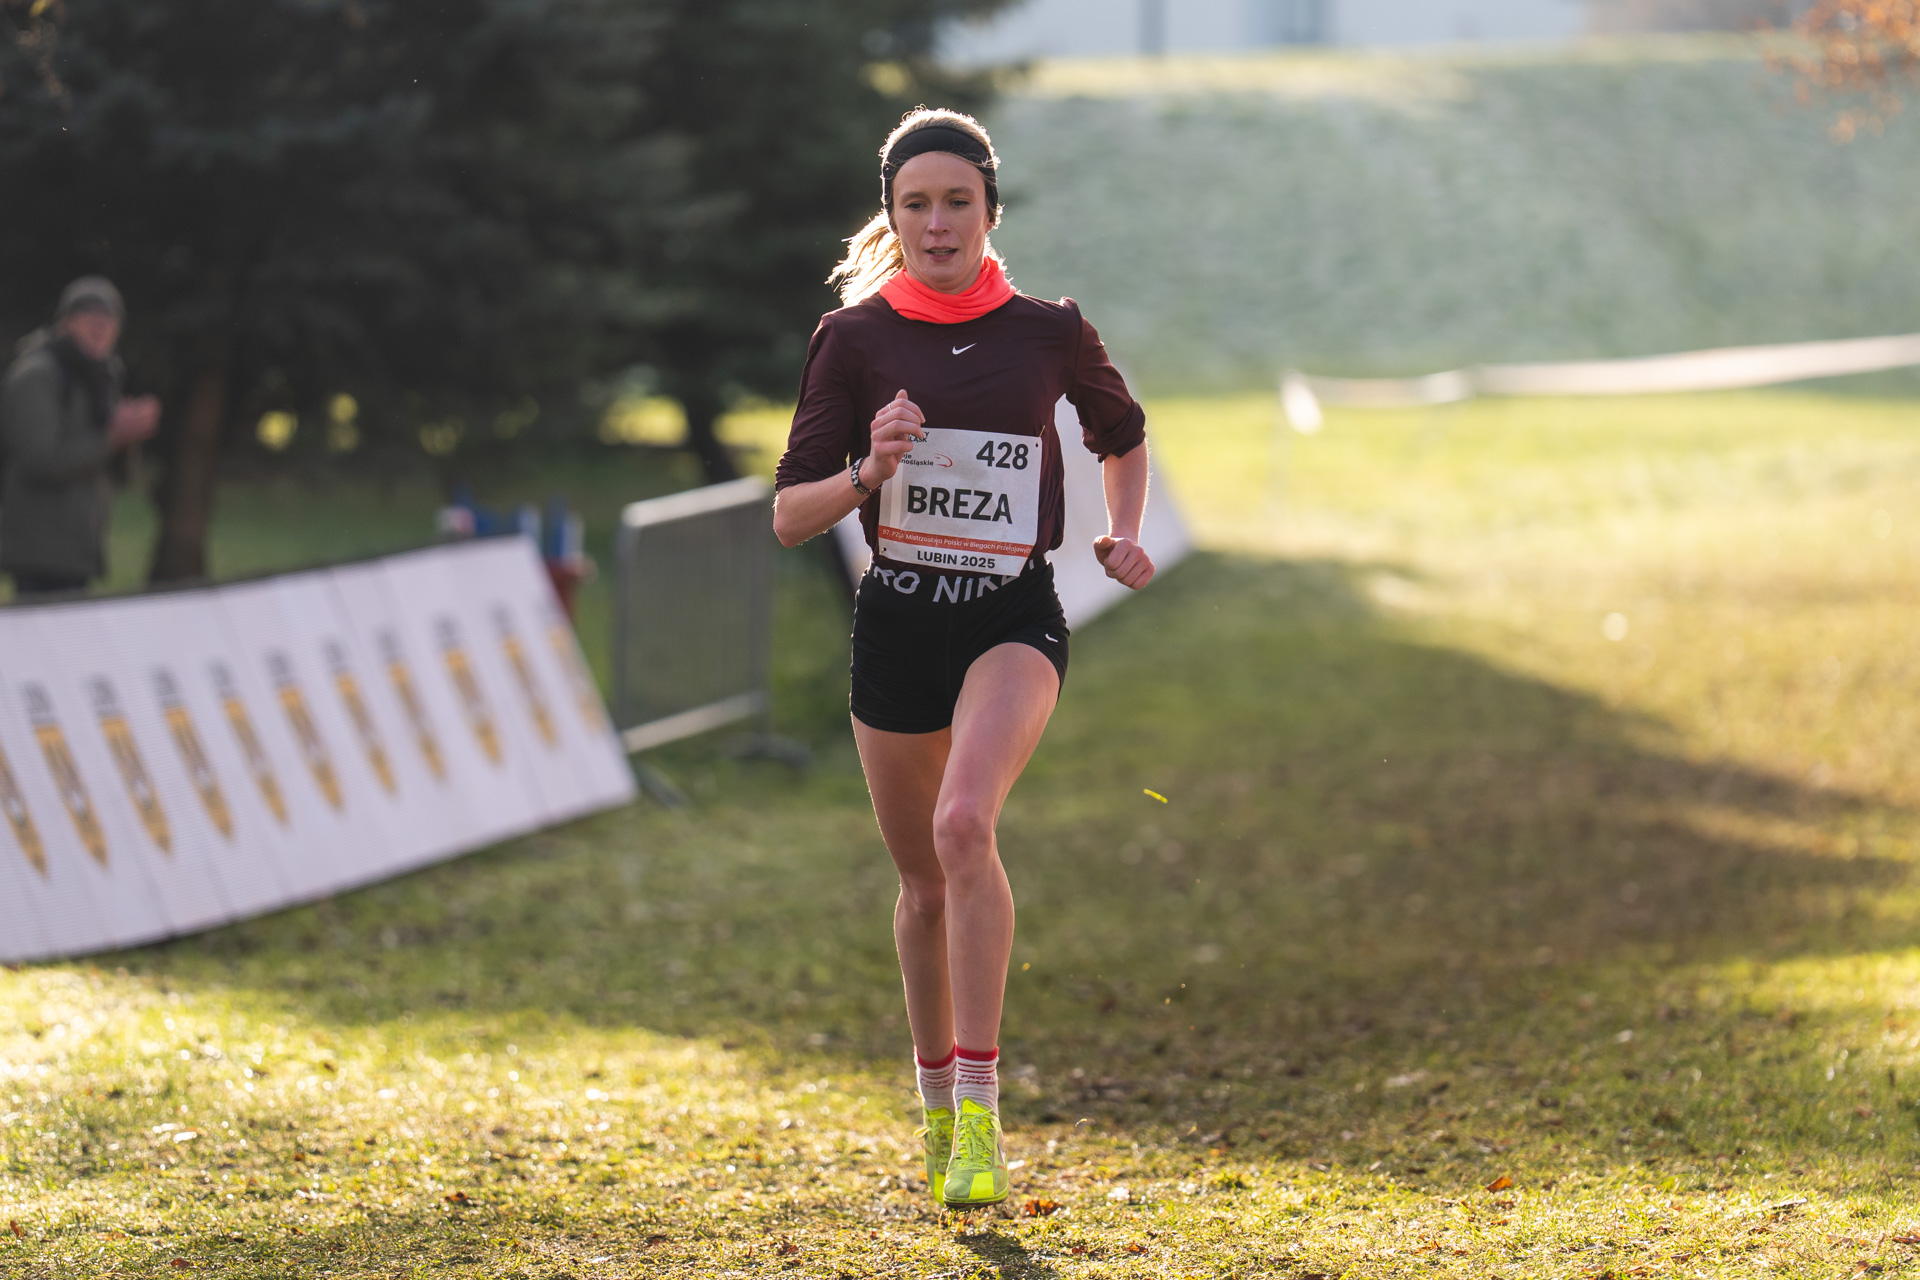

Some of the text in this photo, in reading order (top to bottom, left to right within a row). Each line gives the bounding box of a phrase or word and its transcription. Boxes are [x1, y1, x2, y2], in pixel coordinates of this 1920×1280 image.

[901, 458, 934, 466] nośląskie
[976, 440, 1029, 471] 428
[907, 484, 1013, 525] BREZA
[905, 533, 943, 545] Mistrzostwa
[943, 538, 962, 547] Polski
[969, 541, 996, 550] Biegach
[917, 550, 996, 569] LUBIN 2025
